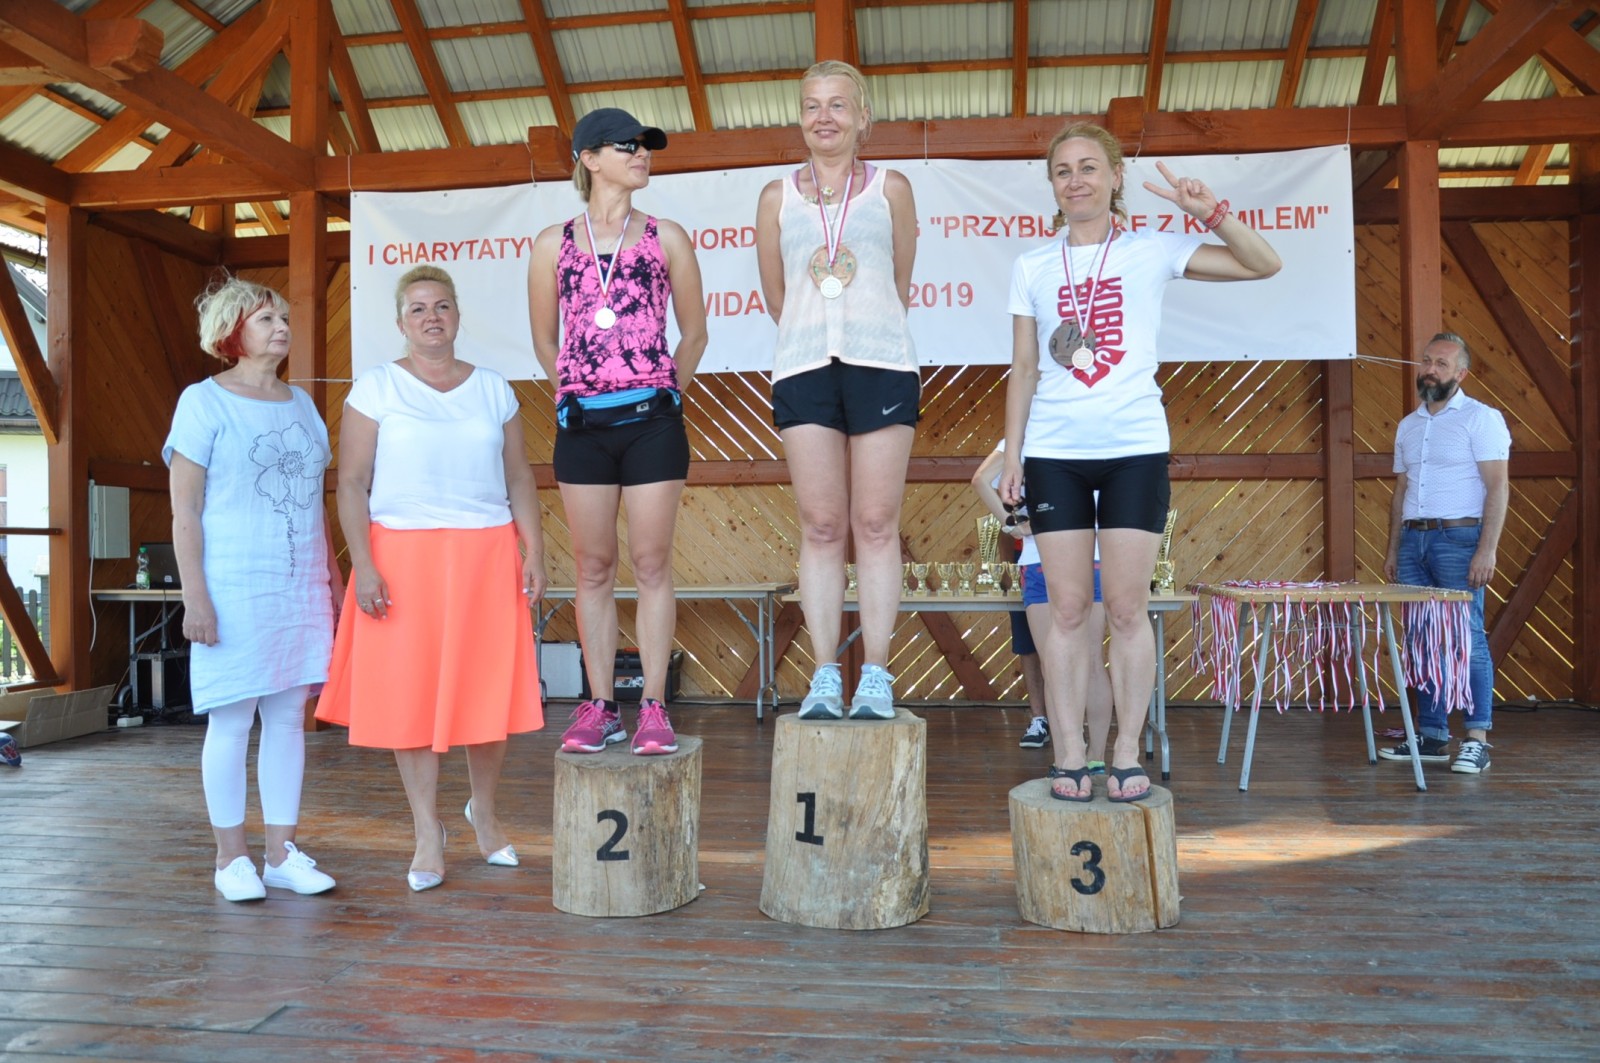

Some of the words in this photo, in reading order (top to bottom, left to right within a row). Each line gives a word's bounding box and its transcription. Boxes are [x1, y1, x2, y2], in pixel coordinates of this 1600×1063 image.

[368, 244, 375, 265] I
[382, 237, 536, 266] CHARYTATY
[908, 281, 974, 308] 2019
[596, 809, 630, 861] 2
[795, 792, 824, 846] 1
[1070, 840, 1106, 895] 3
